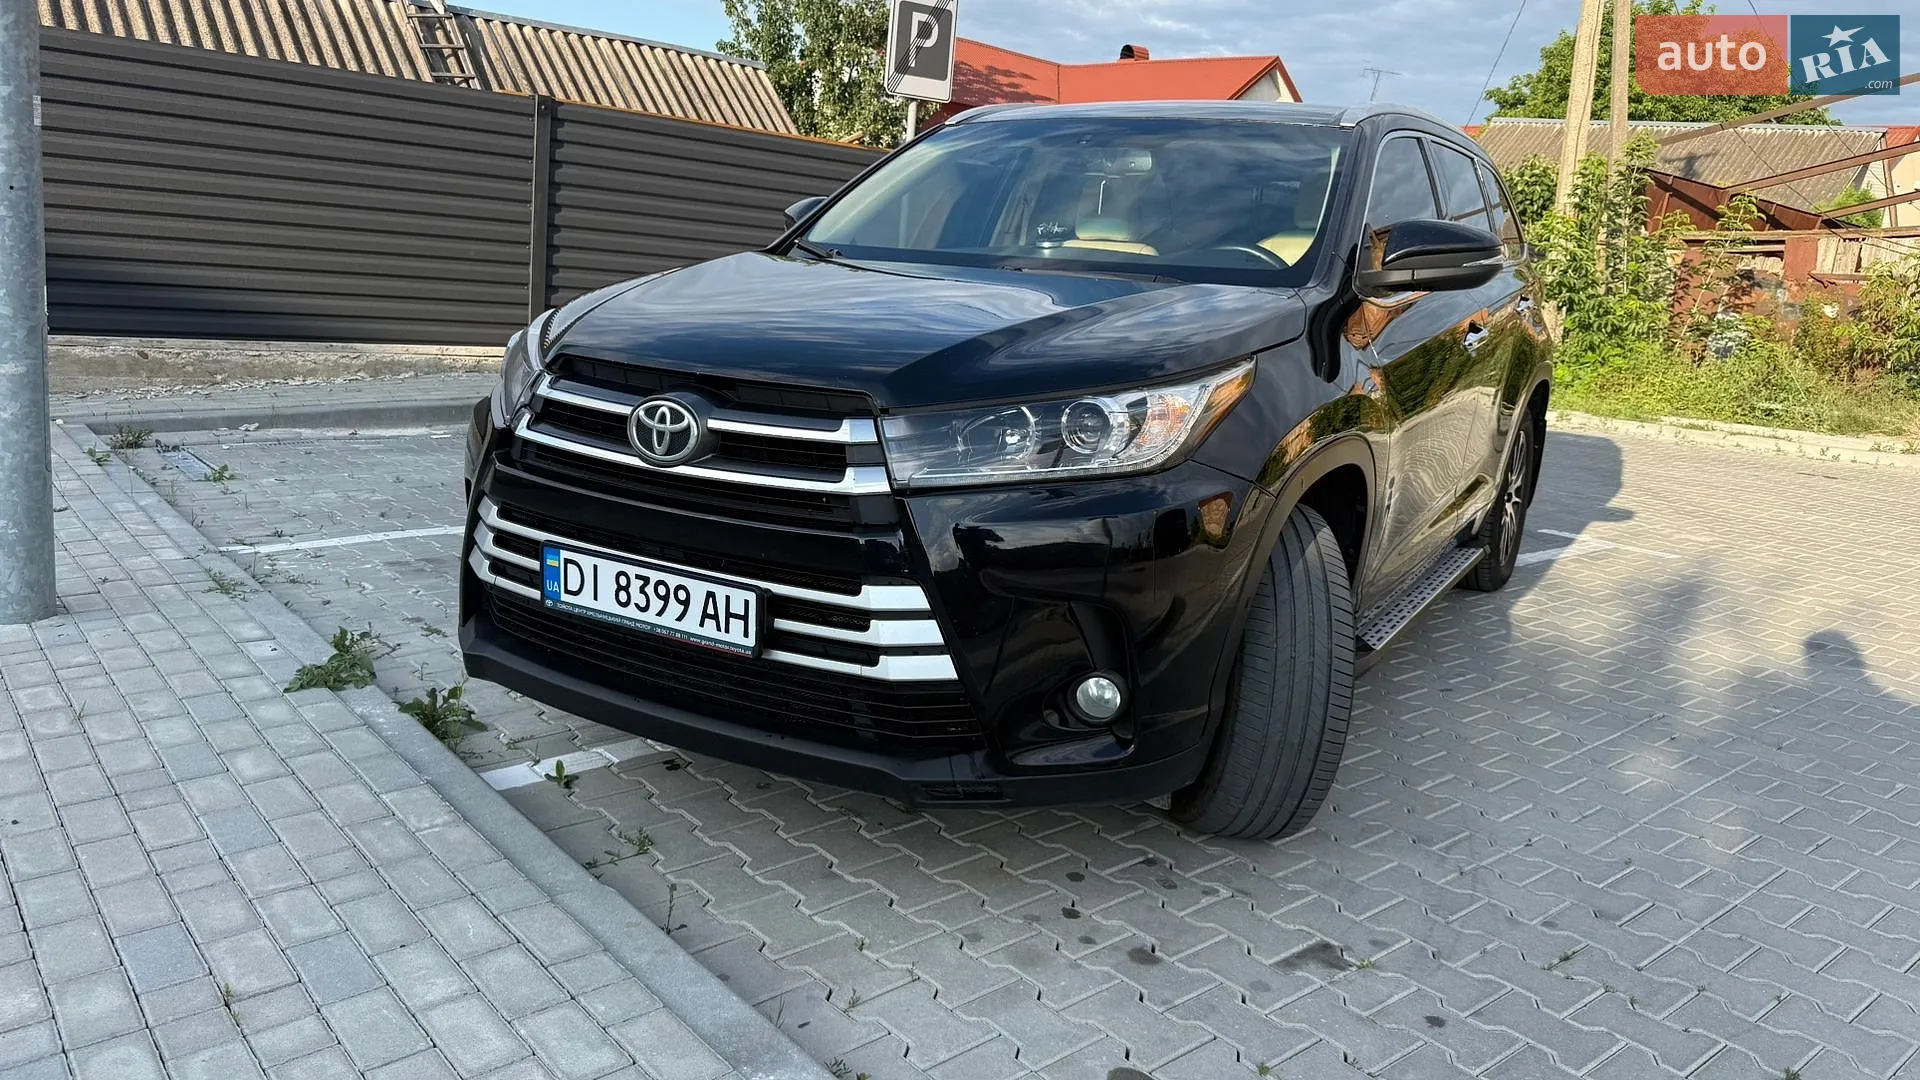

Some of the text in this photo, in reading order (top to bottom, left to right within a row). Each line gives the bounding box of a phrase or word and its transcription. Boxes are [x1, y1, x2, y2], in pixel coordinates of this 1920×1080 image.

[909, 11, 939, 68] P
[546, 579, 560, 593] UA
[563, 557, 750, 639] DI 8399 AH
